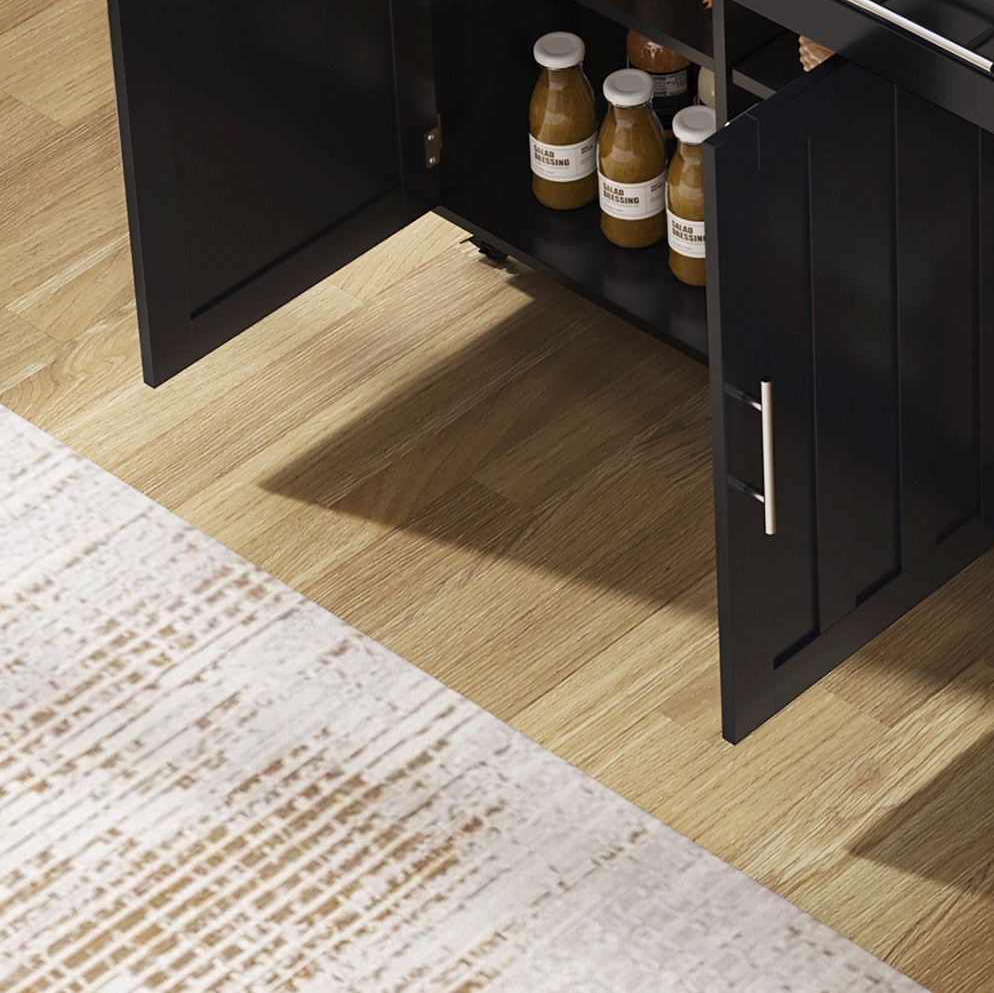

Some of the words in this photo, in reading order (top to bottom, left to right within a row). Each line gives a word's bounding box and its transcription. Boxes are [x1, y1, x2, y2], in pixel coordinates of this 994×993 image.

[533, 144, 555, 158] SALAD
[534, 152, 570, 166] DRESSING
[603, 182, 624, 196] SALAD
[603, 190, 640, 204] DRESSING
[672, 220, 693, 234] SALAD
[672, 227, 706, 242] DRESSIN
